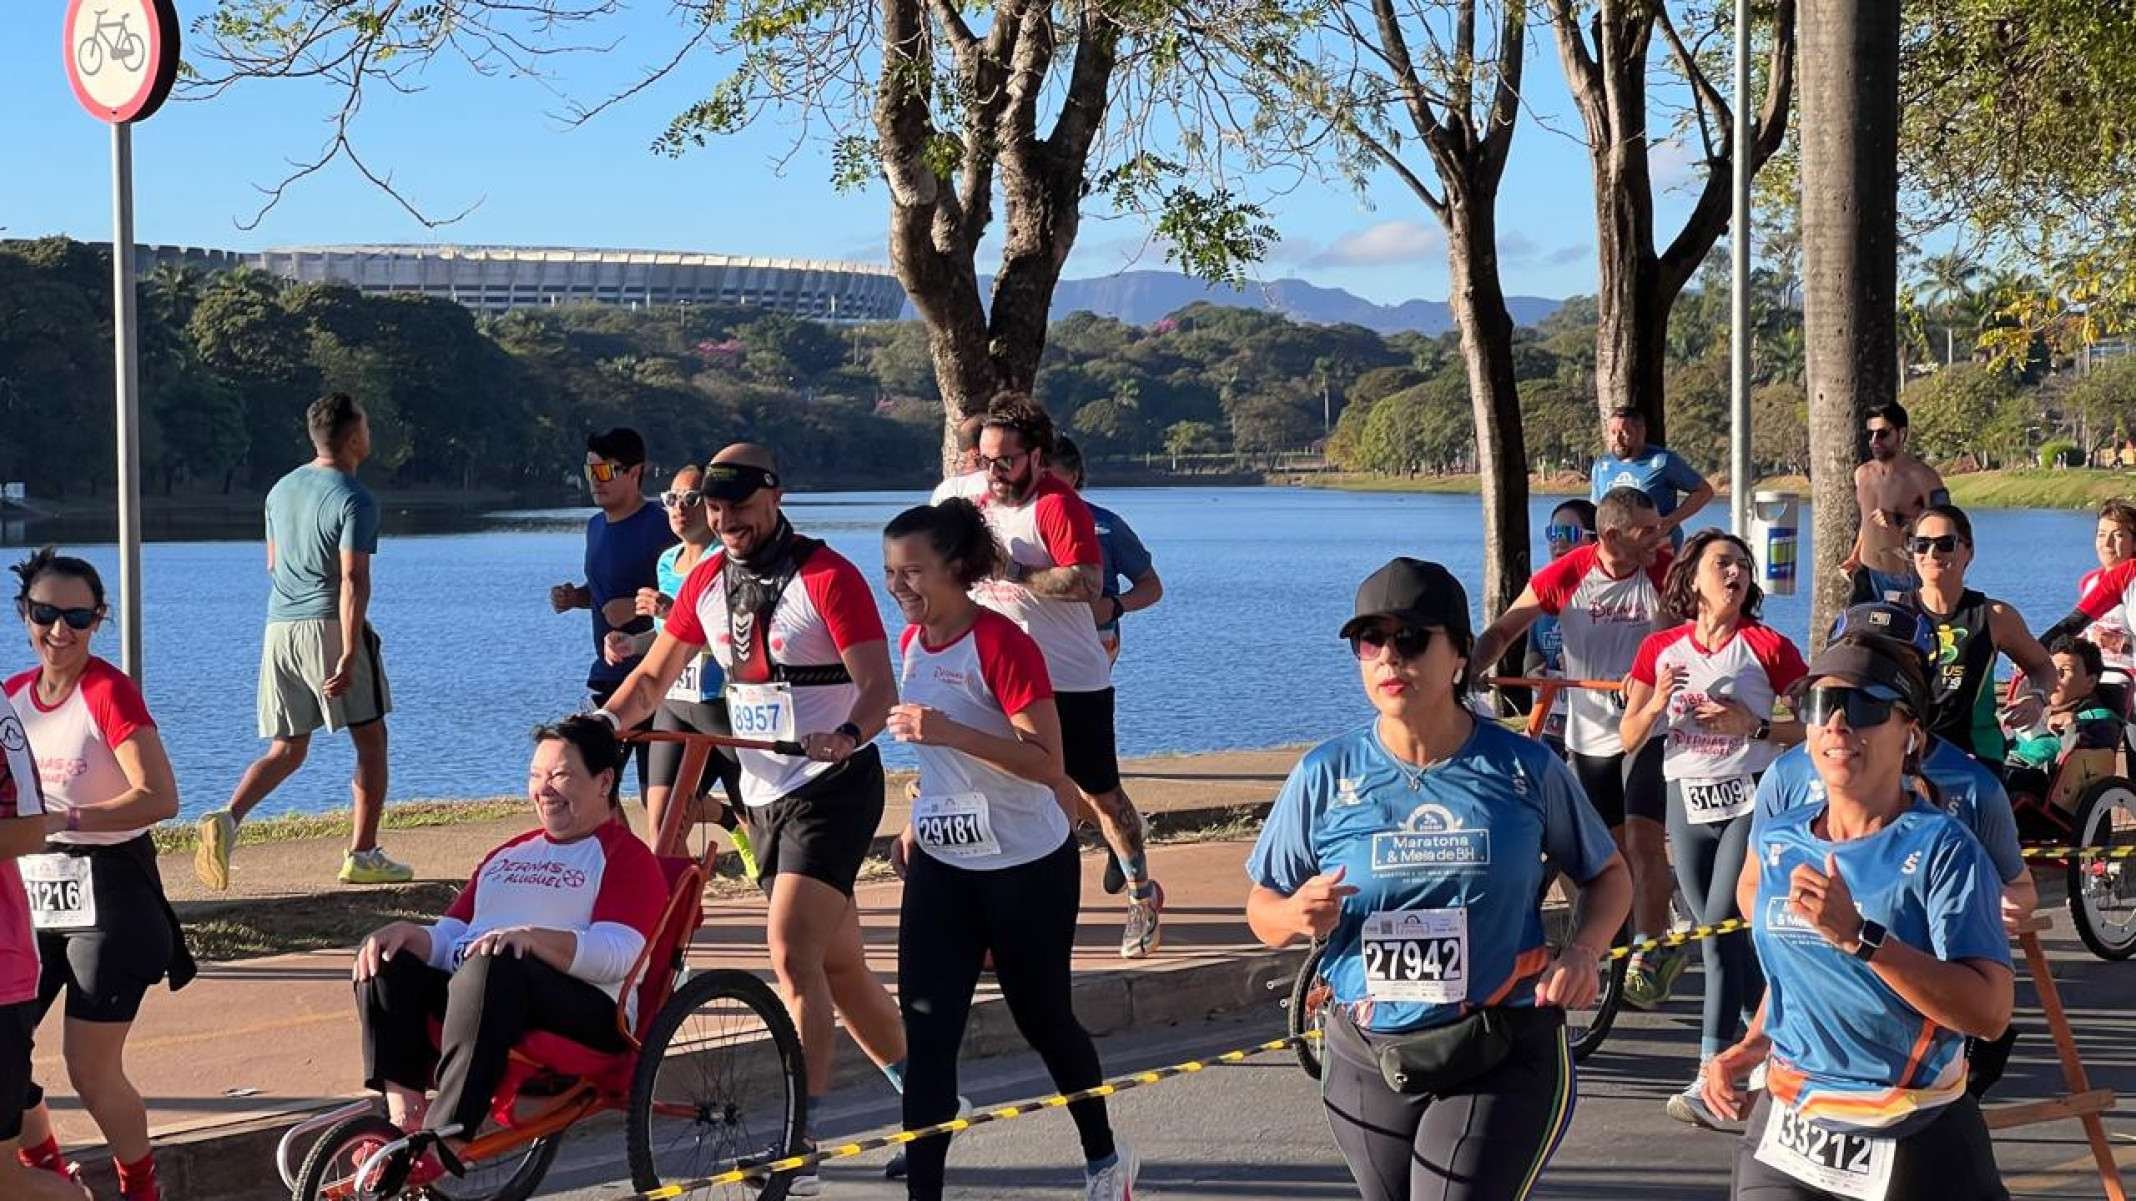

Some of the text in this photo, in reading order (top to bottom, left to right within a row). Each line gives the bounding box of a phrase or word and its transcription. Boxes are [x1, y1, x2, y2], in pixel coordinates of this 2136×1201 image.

[735, 704, 779, 731] 8957
[1688, 781, 1746, 810] 31409
[920, 816, 980, 844] 29181
[1392, 835, 1469, 849] Maratona
[1387, 850, 1398, 863] &
[1436, 846, 1455, 861] de
[1456, 846, 1475, 861] BH
[27, 880, 81, 911] 1216
[1365, 940, 1461, 981] 27942
[1780, 1107, 1871, 1174] 33212
